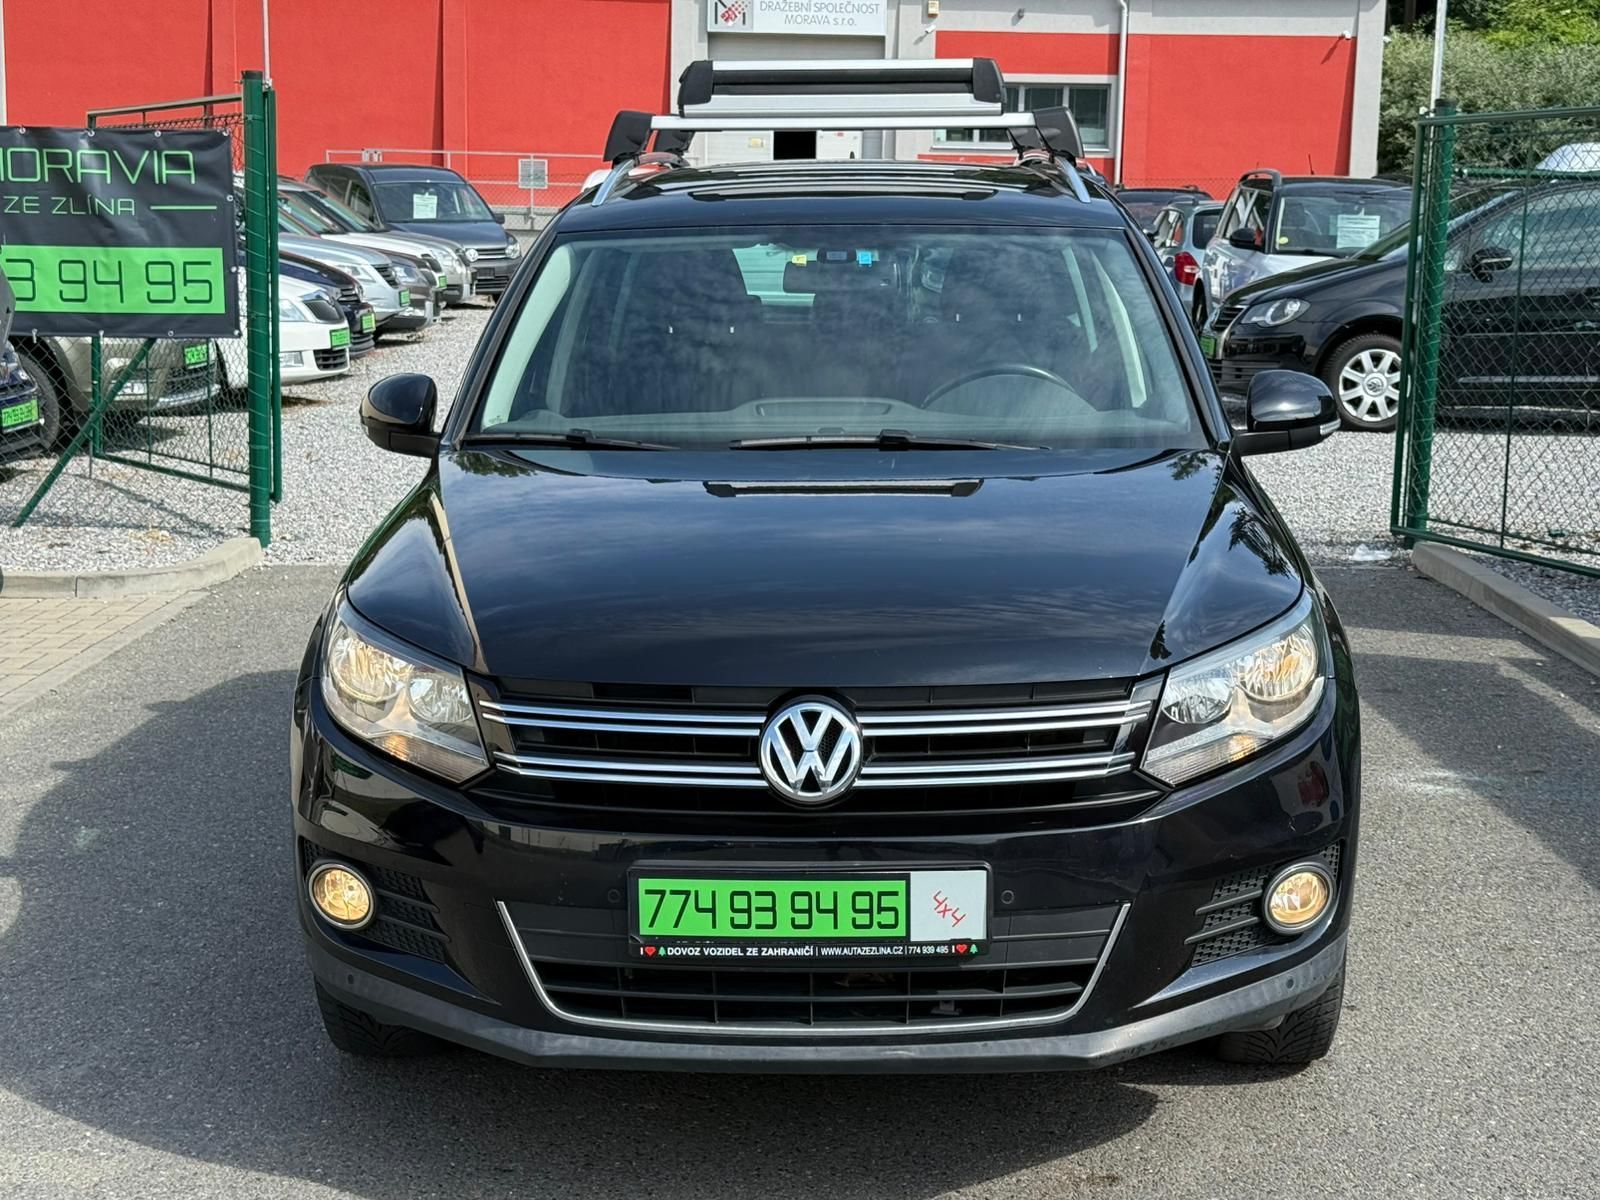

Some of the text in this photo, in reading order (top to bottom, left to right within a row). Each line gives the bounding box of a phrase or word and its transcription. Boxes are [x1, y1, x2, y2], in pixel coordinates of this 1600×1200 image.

[759, 0, 880, 14] DRAŽEBNÍ SPOLEČNOST
[784, 14, 858, 26] MORAVA s.r.o.
[0, 147, 196, 185] ORAVIA
[3, 193, 136, 216] ZE ZLÍNA
[58, 260, 125, 304] 94
[144, 260, 213, 304] 95
[644, 889, 899, 930] 774 93 94 95
[667, 947, 701, 956] DOVOZ
[703, 947, 744, 956] VOZIDEL
[746, 947, 759, 956] ZE
[761, 945, 814, 956] ZAHRANIČÍ
[821, 946, 903, 956] WWW.AUTAZEZLINA.CZ
[908, 946, 921, 954] 774
